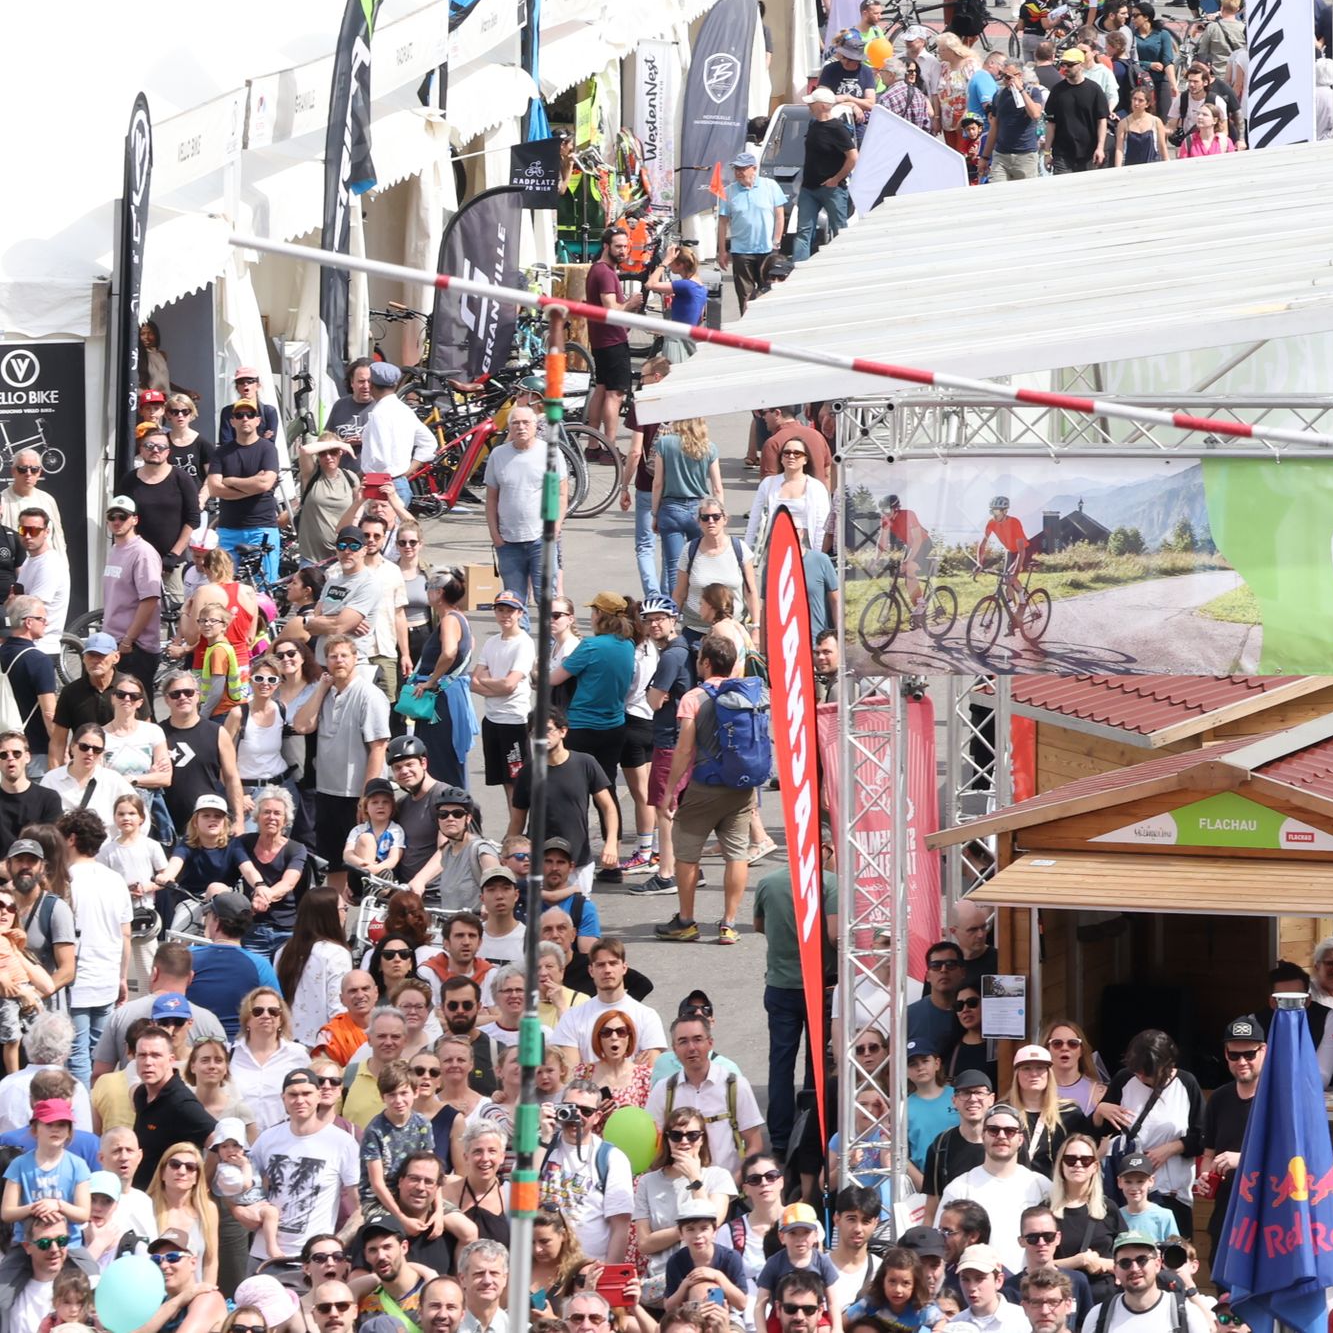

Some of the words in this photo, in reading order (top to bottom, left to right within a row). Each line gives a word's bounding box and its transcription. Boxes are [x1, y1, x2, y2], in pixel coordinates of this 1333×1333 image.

[513, 177, 556, 187] RADPLATZ
[482, 223, 507, 374] GRANILLE
[0, 391, 26, 405] ELLO
[29, 390, 59, 405] BIKE
[1199, 818, 1257, 832] FLACHAU
[1266, 1222, 1304, 1260] Red
